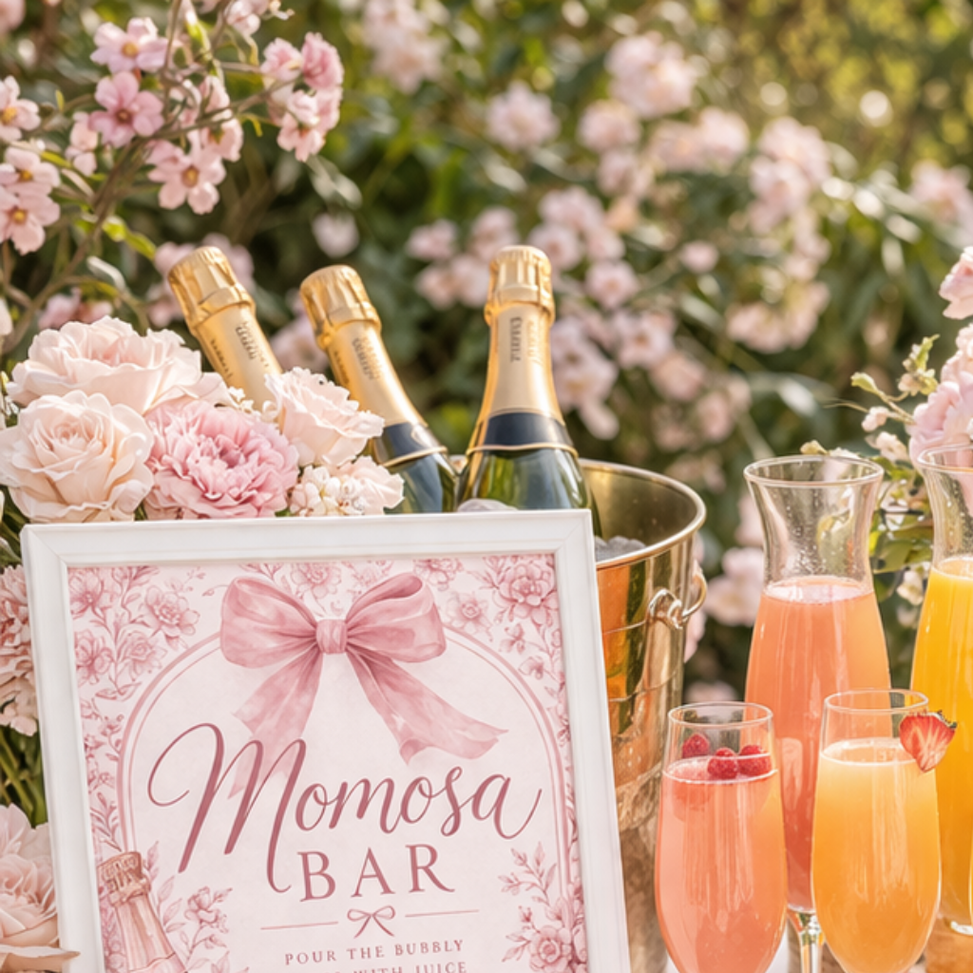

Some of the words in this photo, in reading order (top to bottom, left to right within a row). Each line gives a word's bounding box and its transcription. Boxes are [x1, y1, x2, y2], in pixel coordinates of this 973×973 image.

[148, 722, 542, 893] Momosa
[297, 844, 455, 903] BAR
[284, 950, 337, 966] POUR
[346, 946, 384, 961] THE
[395, 939, 463, 957] BUBBLY
